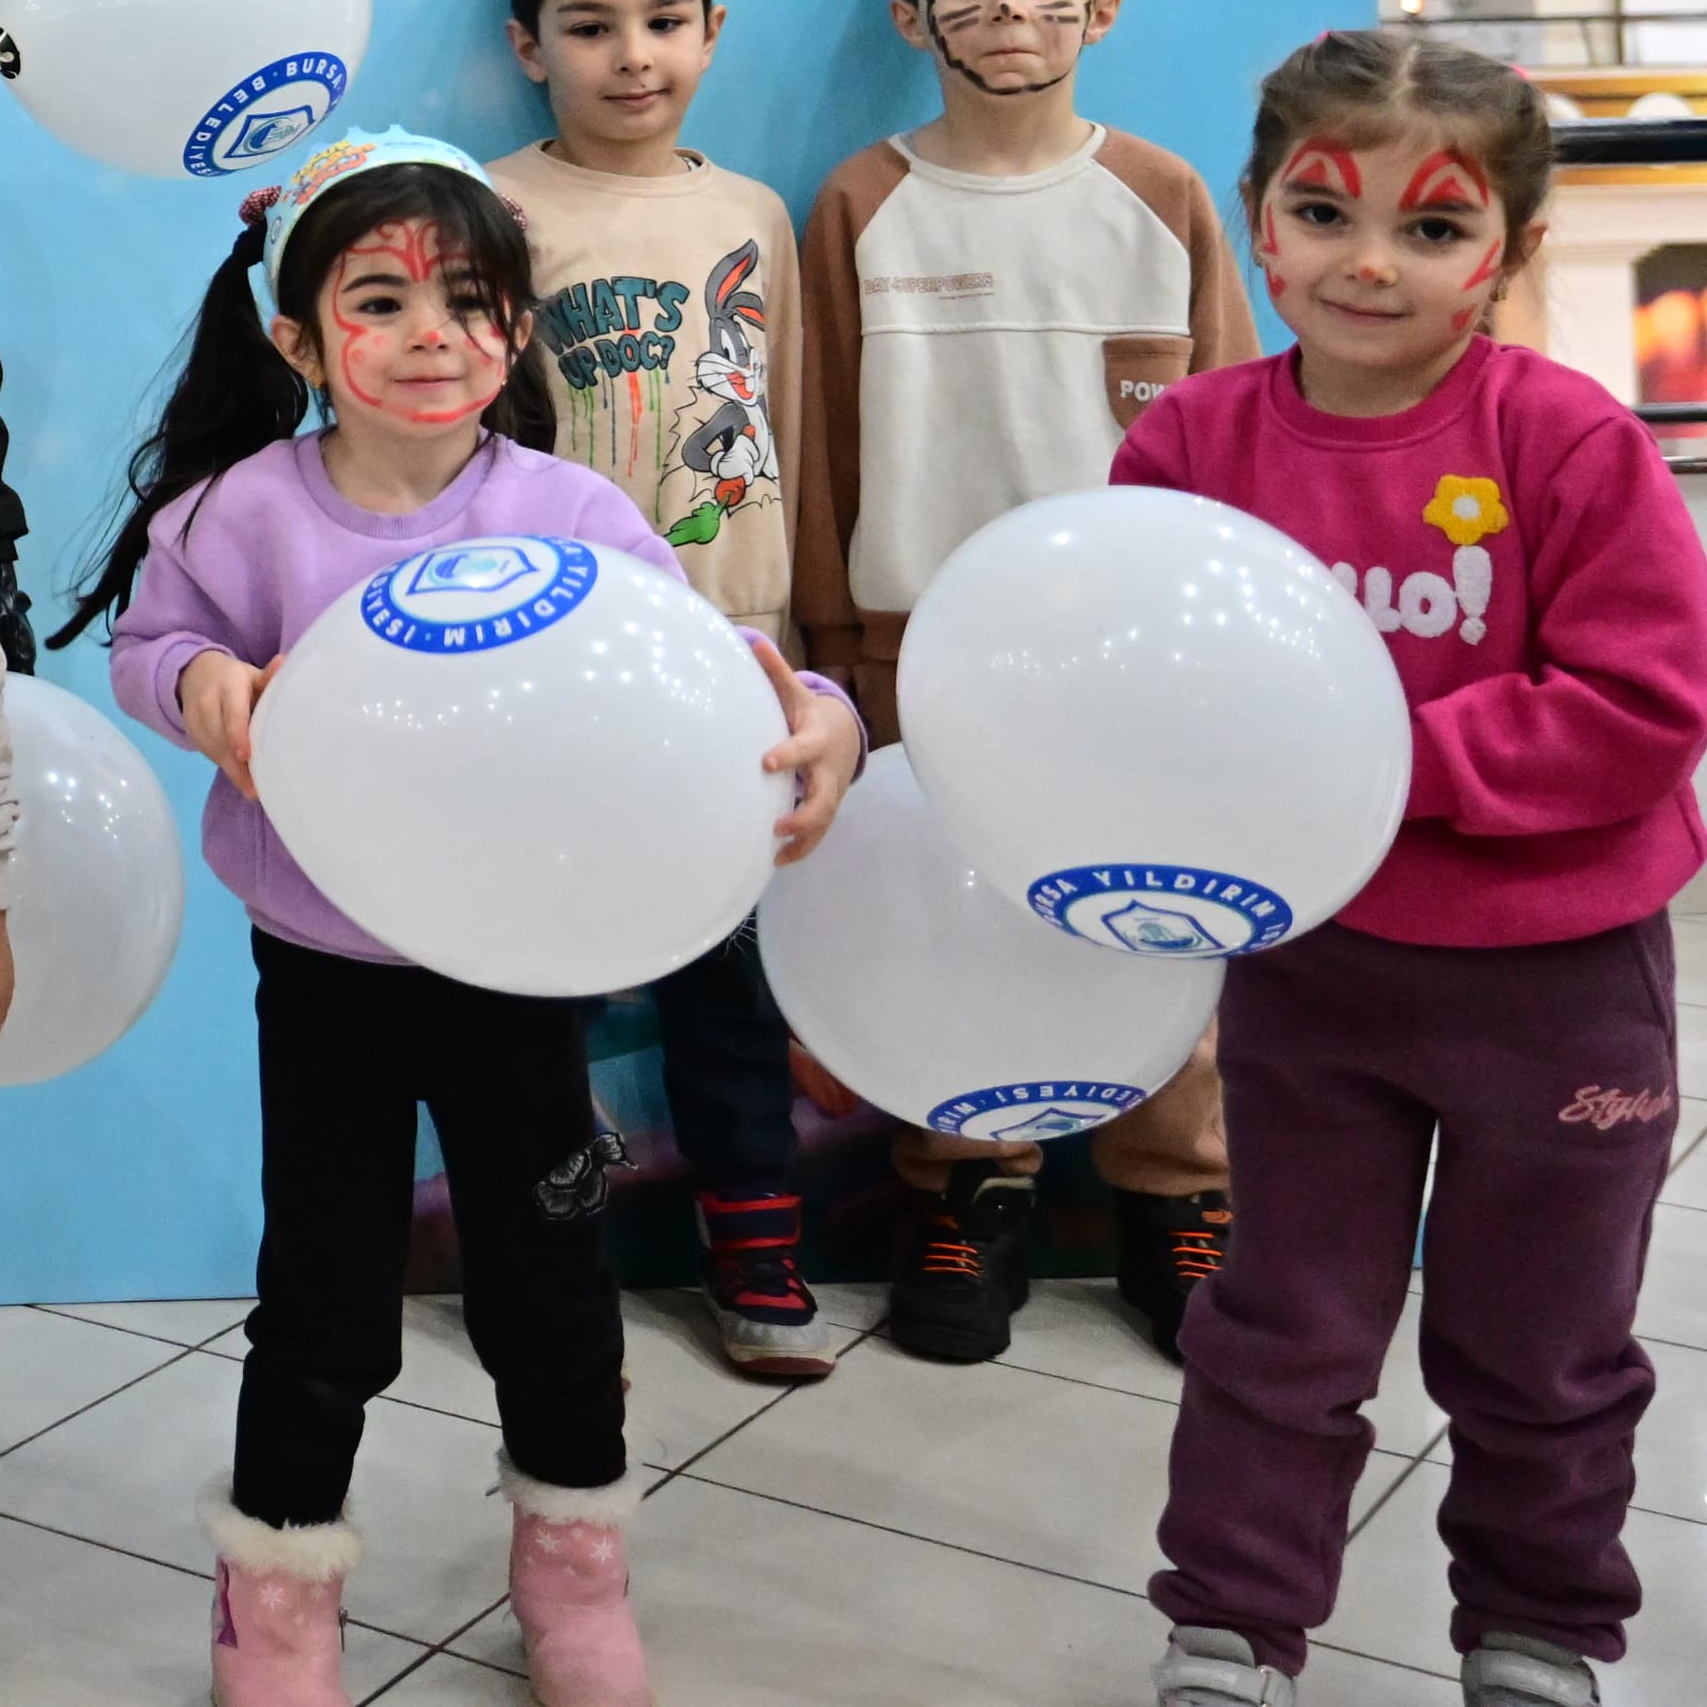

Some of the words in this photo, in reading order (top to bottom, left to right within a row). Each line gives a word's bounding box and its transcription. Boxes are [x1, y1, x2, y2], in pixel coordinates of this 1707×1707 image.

[285, 58, 344, 89] BURSA
[557, 345, 599, 391] UP
[593, 330, 676, 379] DOC?
[443, 565, 589, 647] YILDIRIM
